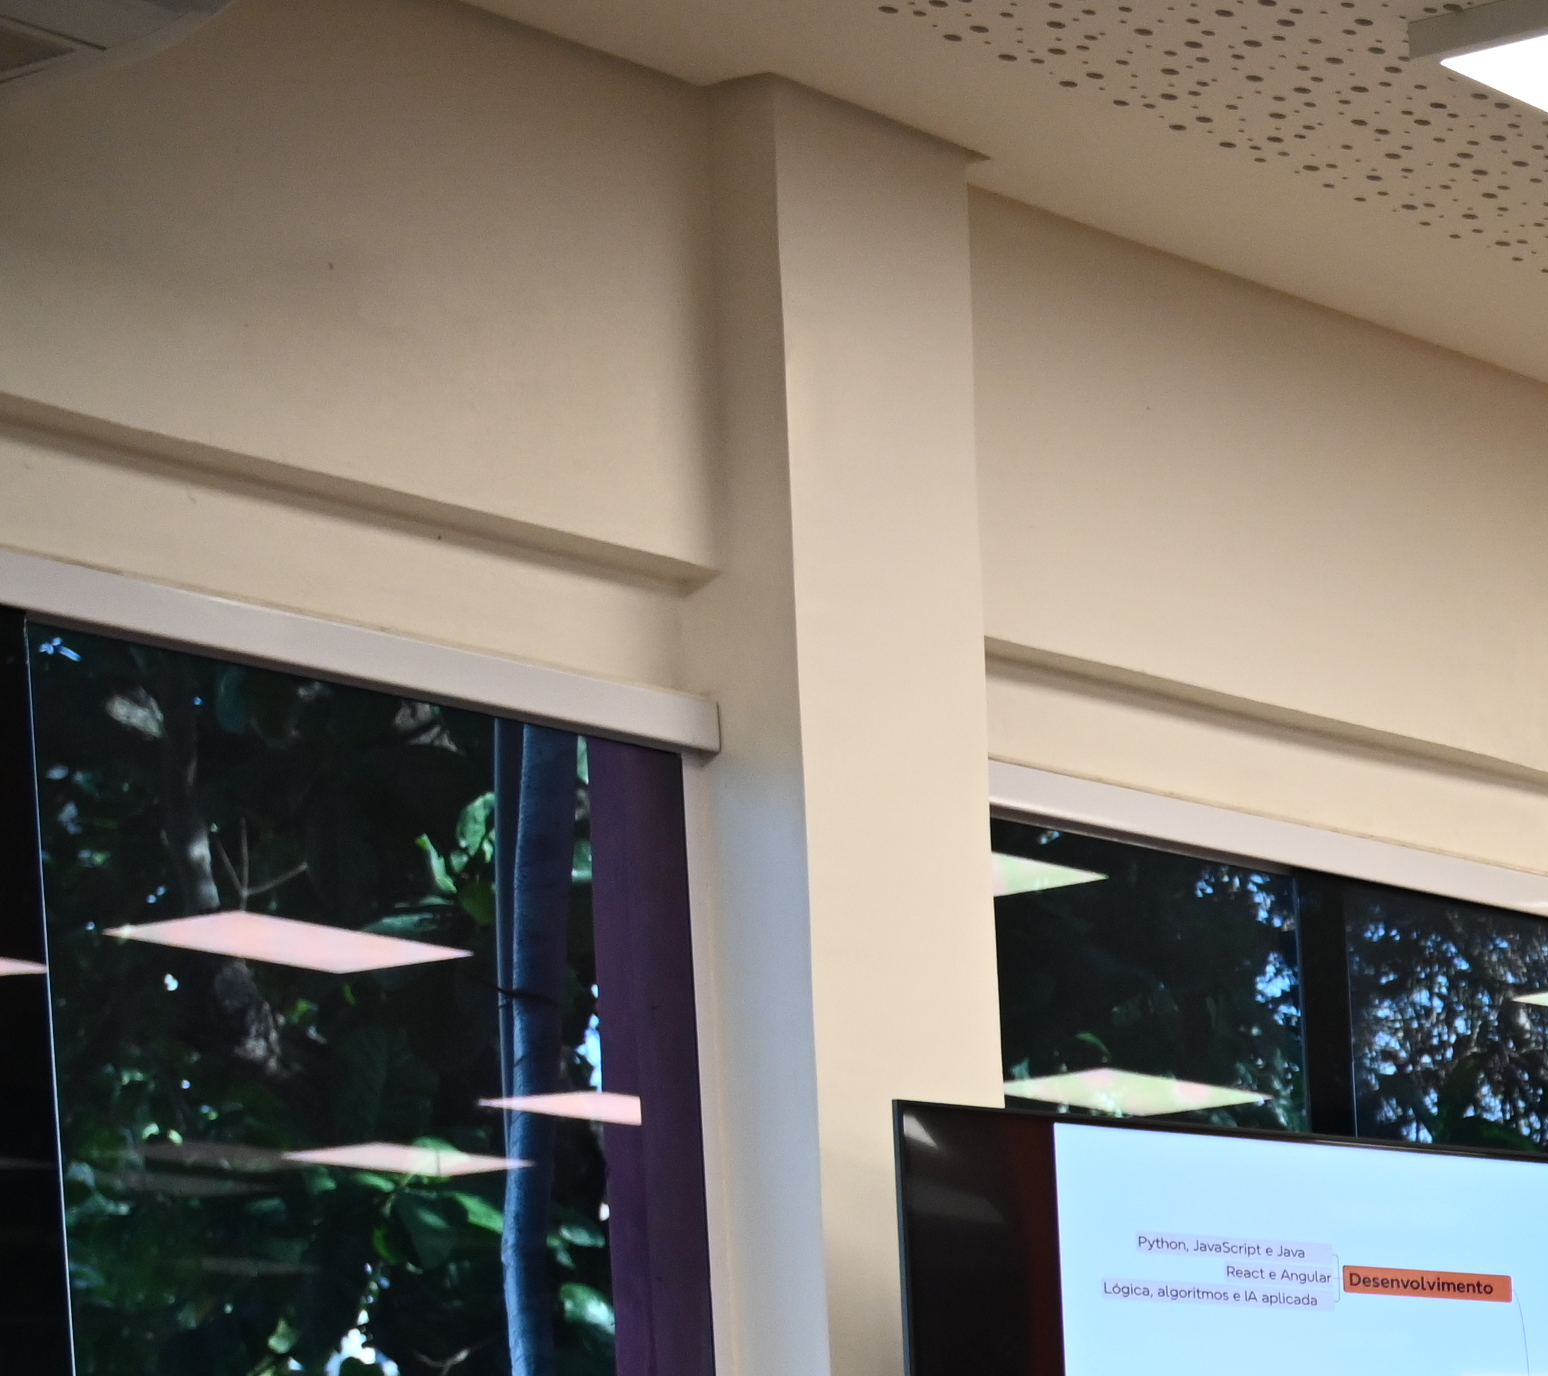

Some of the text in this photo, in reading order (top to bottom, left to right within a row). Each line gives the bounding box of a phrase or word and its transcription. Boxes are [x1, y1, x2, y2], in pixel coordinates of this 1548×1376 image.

[1137, 1235, 1306, 1259] Python, JavaScript e Java
[1226, 1265, 1332, 1286] React e Angular
[1348, 1272, 1494, 1296] Desenvolvimento
[1103, 1281, 1319, 1308] Lógica, algoritmos e IA aplicada
